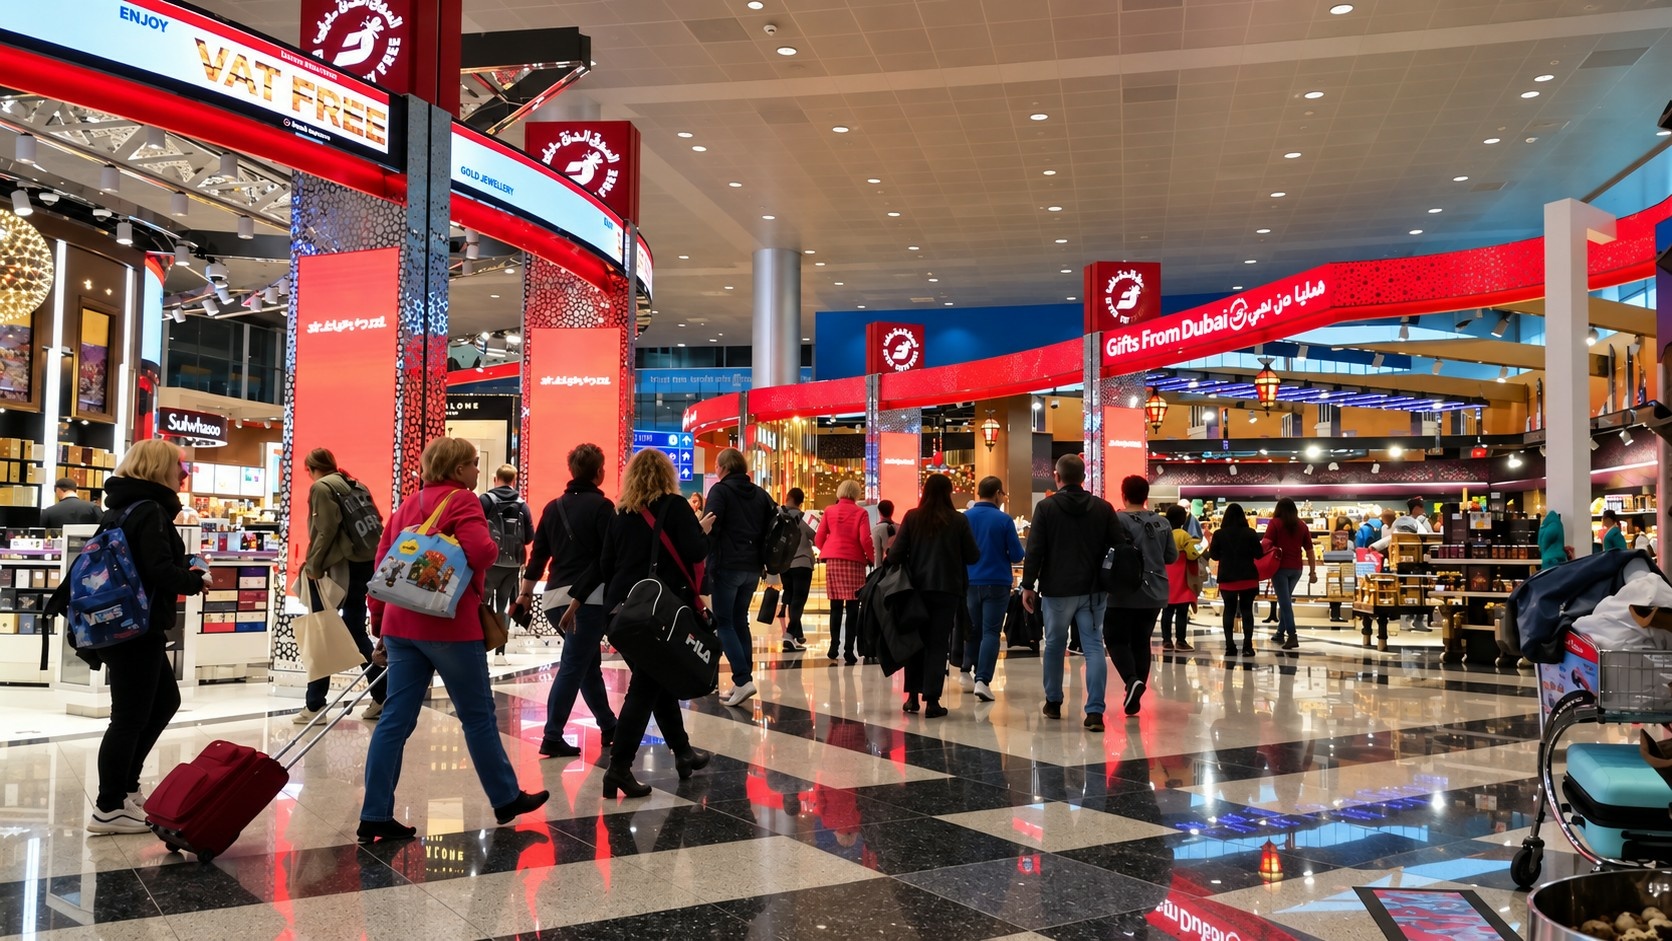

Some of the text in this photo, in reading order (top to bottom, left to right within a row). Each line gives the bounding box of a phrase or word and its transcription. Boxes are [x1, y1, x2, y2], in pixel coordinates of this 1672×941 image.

[120, 6, 169, 33] ENJOY
[194, 37, 281, 102] VAT
[291, 75, 386, 146] FREE
[460, 165, 514, 196] GOLD JEWELLERY
[1106, 309, 1228, 357] Gifts From Dubai
[685, 633, 712, 665] FILA
